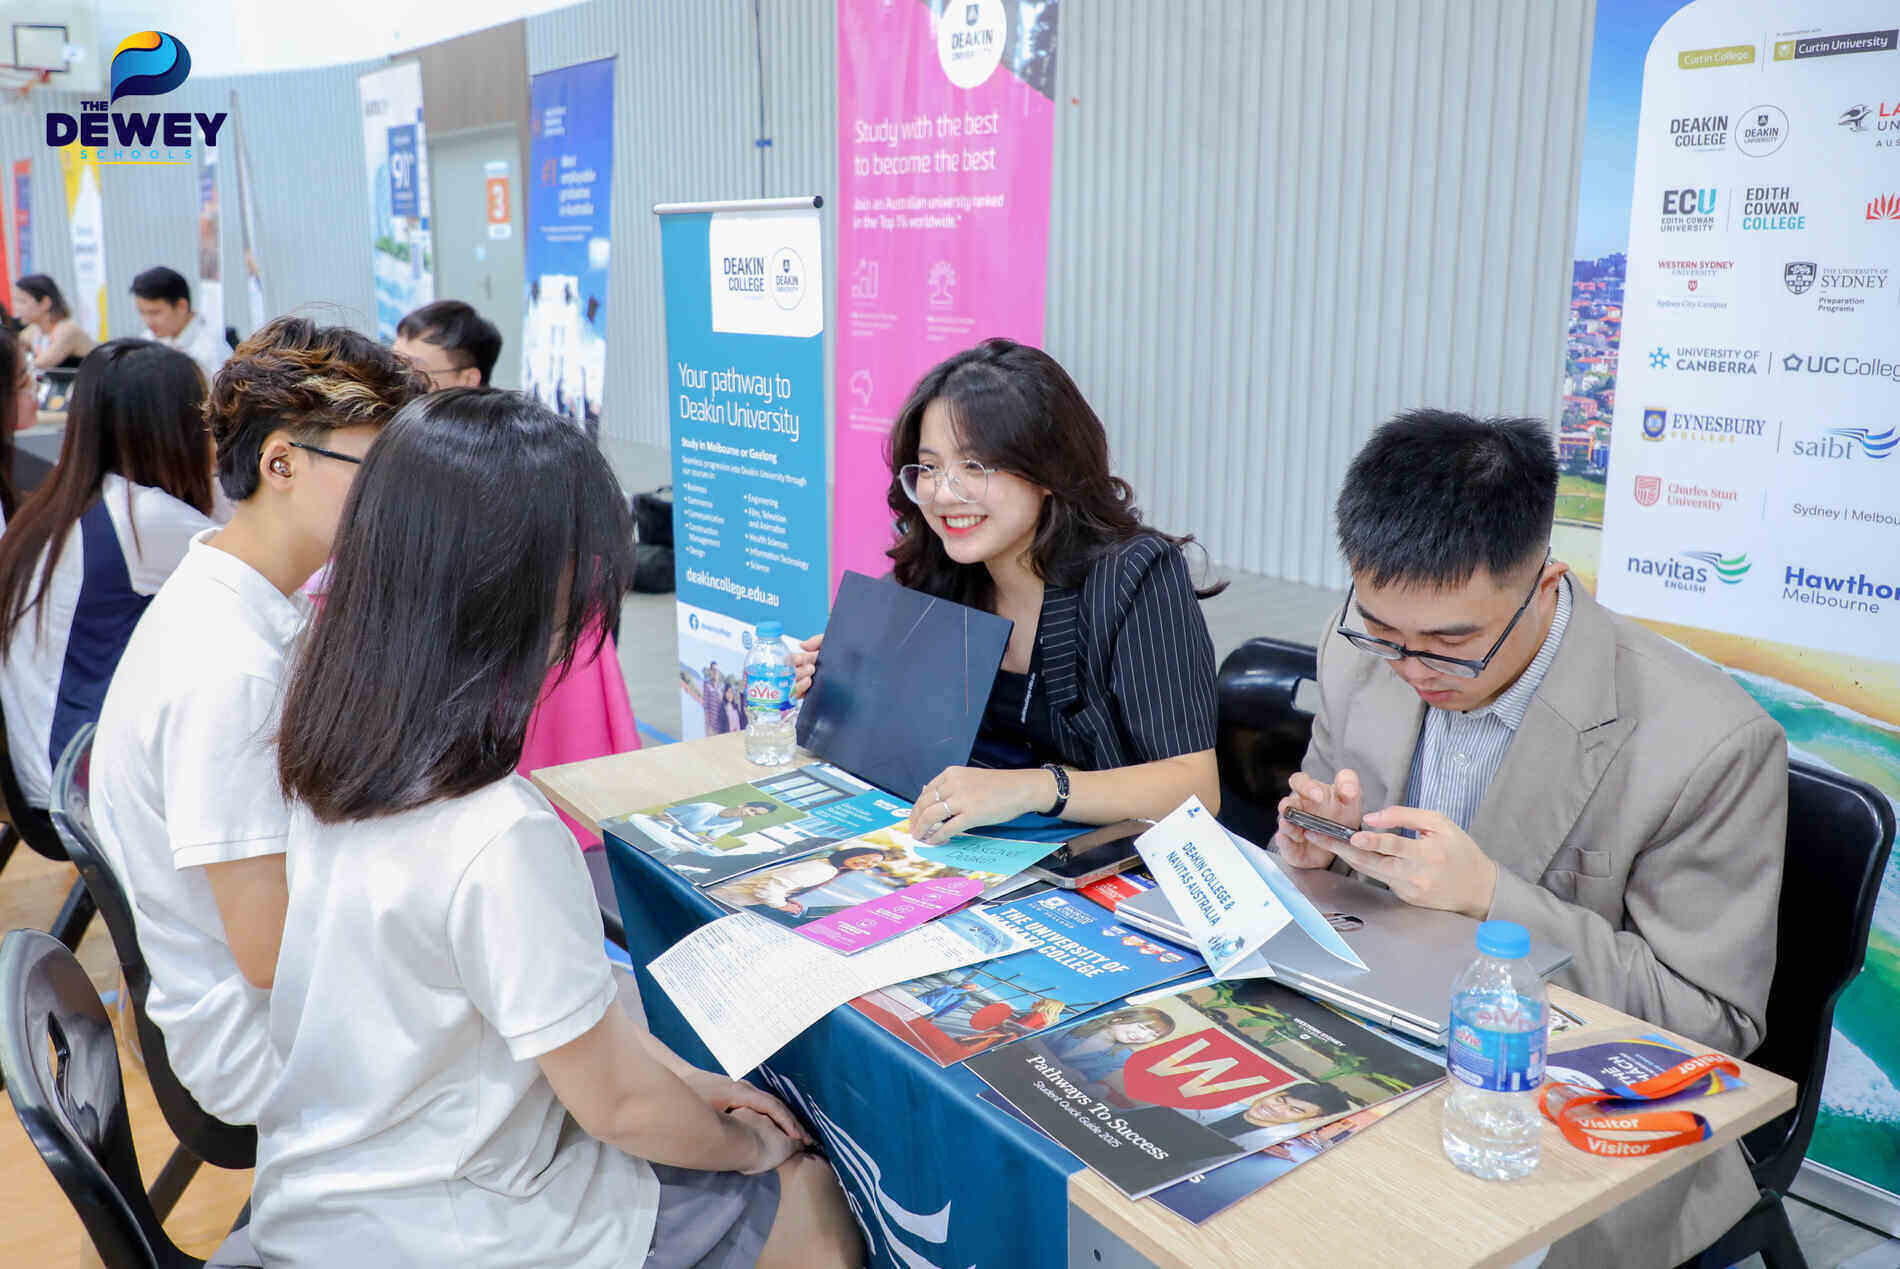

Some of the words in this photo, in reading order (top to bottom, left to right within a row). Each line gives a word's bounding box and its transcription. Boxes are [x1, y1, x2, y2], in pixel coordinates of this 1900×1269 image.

[952, 29, 993, 49] DEAKIN
[1799, 41, 1829, 54] Curtin
[1832, 36, 1888, 51] University
[1684, 53, 1712, 65] Curtin
[1714, 51, 1749, 64] College
[855, 118, 898, 147] Study
[902, 113, 933, 139] with
[937, 113, 961, 137] the
[964, 109, 999, 135] best
[1671, 115, 1728, 133] DEAKIN
[1744, 127, 1779, 138] DEAKIN
[1675, 133, 1727, 147] COLLEGE
[854, 155, 870, 176] to
[873, 153, 931, 175] become
[934, 149, 960, 172] the
[963, 147, 997, 171] best
[492, 183, 505, 219] 3
[1663, 188, 1717, 215] ECU
[1746, 187, 1790, 201] EDITH
[1744, 202, 1799, 216] COWAN
[1660, 224, 1713, 232] UNIVERSITY
[1686, 216, 1714, 224] COWAN
[1743, 216, 1806, 230] COLLEGE
[723, 257, 765, 275] DEAKIN
[1658, 260, 1699, 269] WESTERN
[1700, 260, 1734, 269] SYDNEY
[728, 277, 765, 292] COLLEGE
[775, 275, 799, 286] DEAKIN
[1820, 275, 1888, 288] SYDNEY
[1818, 305, 1855, 313] Programs
[1819, 297, 1865, 306] Preparation
[1677, 348, 1743, 359] UNIVERSITY
[1745, 350, 1760, 360] OF
[1676, 359, 1757, 375] CANBERRA
[1808, 356, 1839, 373] UC
[678, 361, 707, 389] Your
[711, 366, 773, 404] pathway
[776, 372, 791, 399] to
[680, 395, 724, 425] Deakin
[728, 402, 800, 442] University
[1672, 413, 1766, 435] EYNESBURY
[681, 437, 698, 451] Study
[706, 441, 740, 457] Melbourne
[749, 448, 778, 465] Geelong
[1793, 437, 1855, 459] saibt
[748, 493, 779, 509] Engineering
[1668, 483, 1708, 497] Charles
[1710, 487, 1738, 501] Sturt
[1667, 496, 1722, 511] University
[1793, 503, 1840, 520] Sydney
[1627, 557, 1708, 583] navitas
[686, 568, 780, 607] deakincollege.edu.au
[1664, 580, 1706, 593] ENGLISH
[1782, 587, 1879, 613] Melbourne
[746, 684, 780, 699] aVie
[1181, 841, 1205, 872] DEAKIN
[1200, 867, 1231, 907] COLLEGE
[1223, 901, 1236, 912] &
[1165, 850, 1192, 885] NAVITAS
[1186, 882, 1223, 927] AUSTRALIA
[1000, 908, 1032, 925] THE
[1025, 922, 1111, 964] UNIVERSITY
[1101, 961, 1131, 974] OF
[1038, 945, 1105, 978] COLLEGE
[1145, 1037, 1271, 1098] W
[1025, 1054, 1093, 1106] Pathways
[1088, 1102, 1112, 1121] To
[1107, 1118, 1169, 1160] Success
[1033, 1080, 1062, 1102] Student
[1059, 1100, 1082, 1119] Quick
[1078, 1115, 1103, 1136] Guide
[1099, 1132, 1123, 1148] 2025
[1577, 1118, 1639, 1130] Visitor
[1587, 1136, 1650, 1154] Visitor
